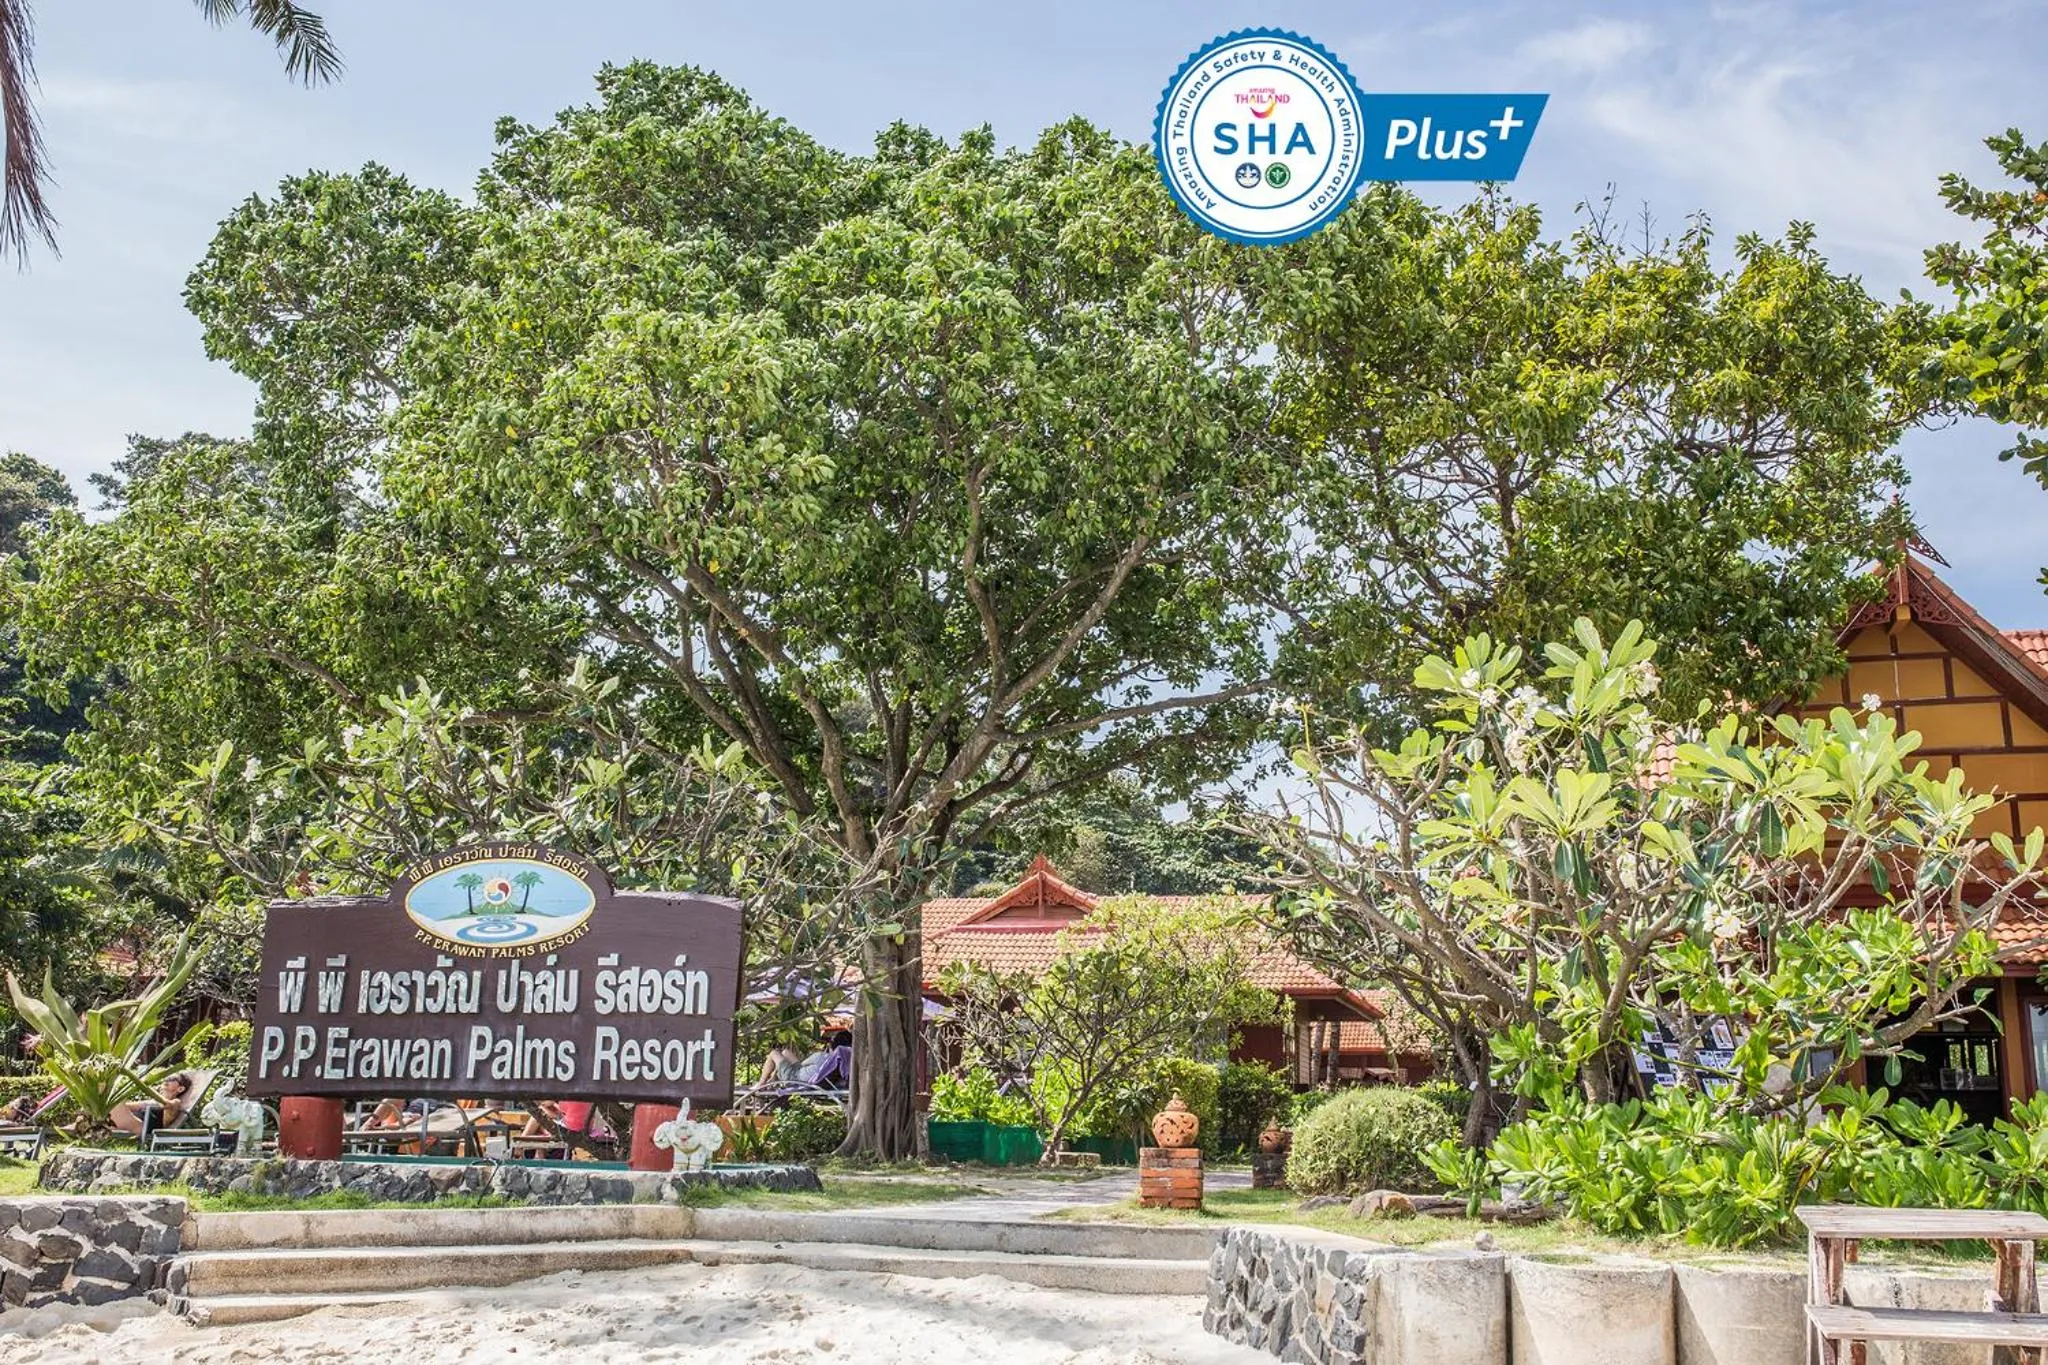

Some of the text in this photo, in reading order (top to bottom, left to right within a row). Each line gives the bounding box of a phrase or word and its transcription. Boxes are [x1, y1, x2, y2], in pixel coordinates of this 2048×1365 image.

[434, 939, 486, 958] ERAWAN
[492, 945, 535, 958] PALMS
[539, 922, 591, 954] RESORT
[357, 954, 482, 1015] เอราวัณ
[496, 953, 579, 1014] ปาล์ม
[594, 953, 709, 1015] รีสอร์ท
[467, 1024, 576, 1082] Palms
[593, 1026, 715, 1081] Resort
